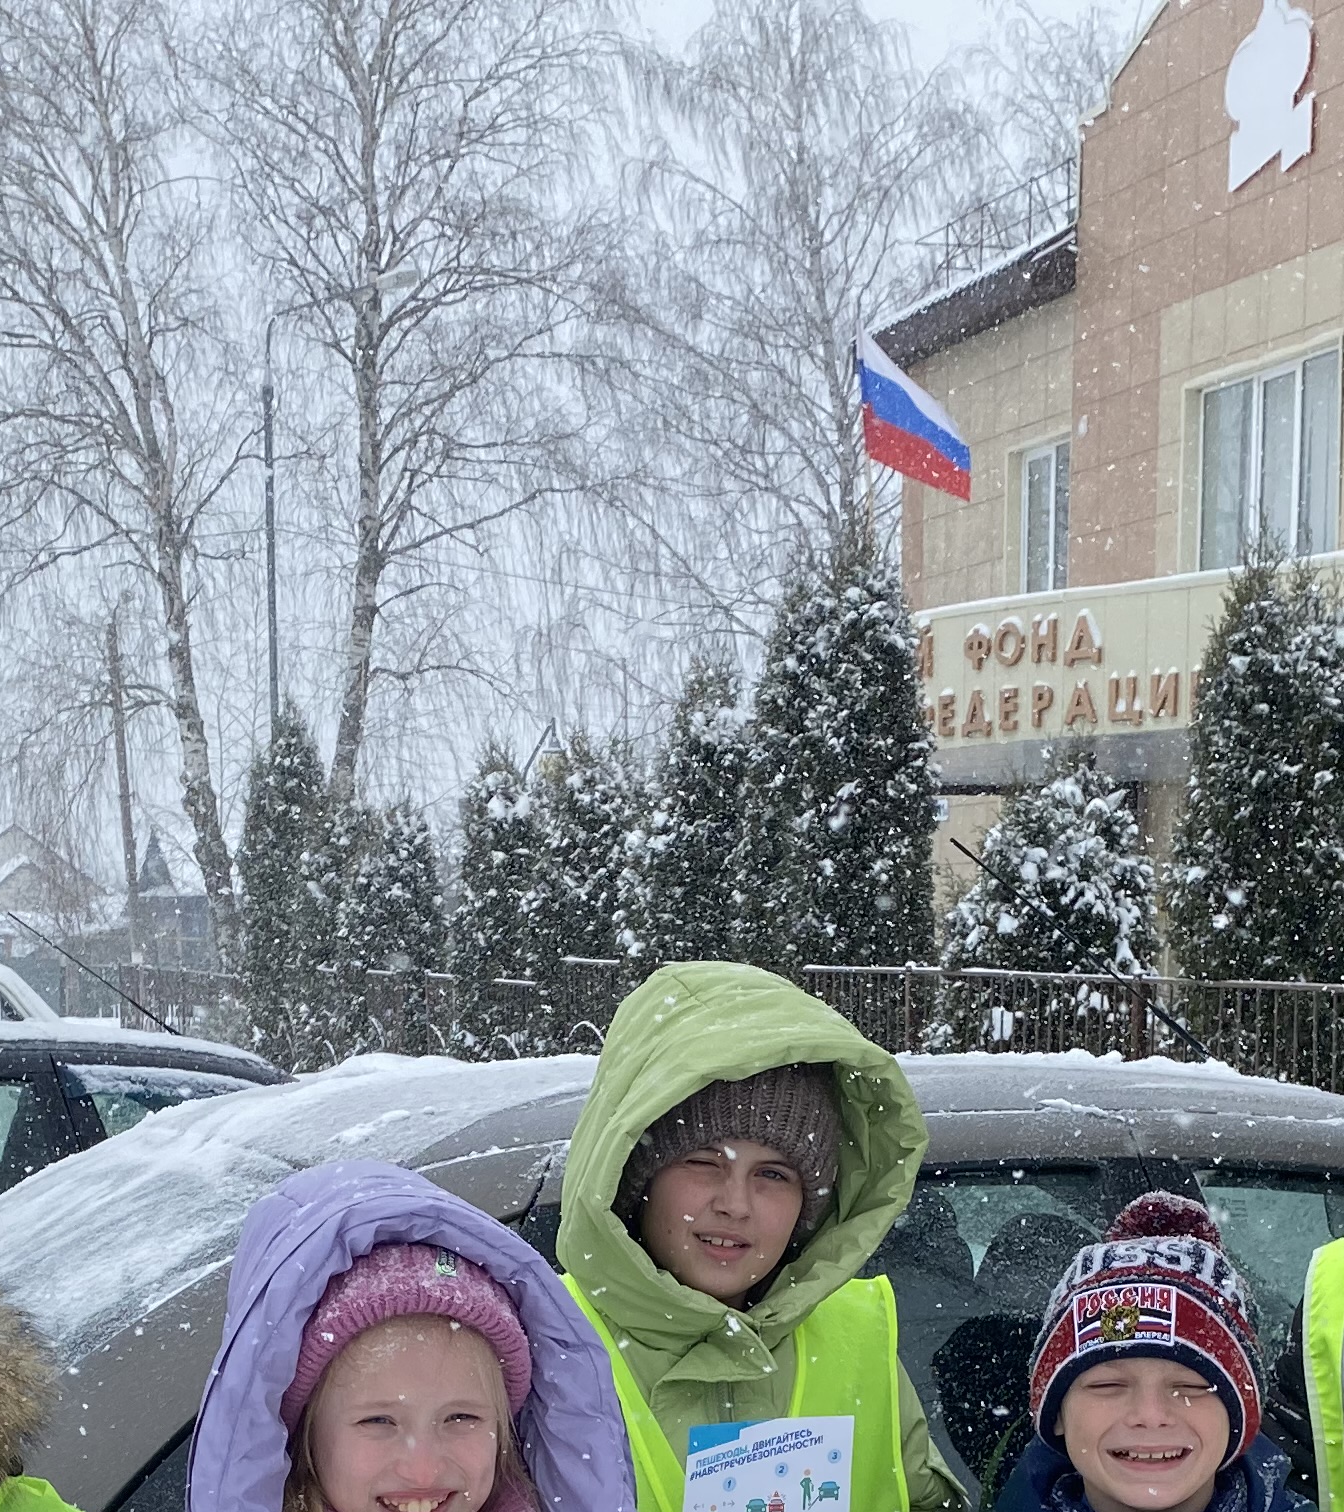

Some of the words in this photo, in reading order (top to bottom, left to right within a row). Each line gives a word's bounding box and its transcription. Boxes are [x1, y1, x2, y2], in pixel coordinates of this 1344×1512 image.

[963, 613, 1102, 671] ФОНД
[921, 670, 1201, 737] ЕДЕРАЦИ
[689, 1435, 824, 1481] #НАВСТРЕЧУБЕЗОПАСНОСТИ!
[695, 1445, 750, 1469] ПЕШЕХОДЫ,
[751, 1428, 813, 1453] ДВИГАЙТЕСЬ
